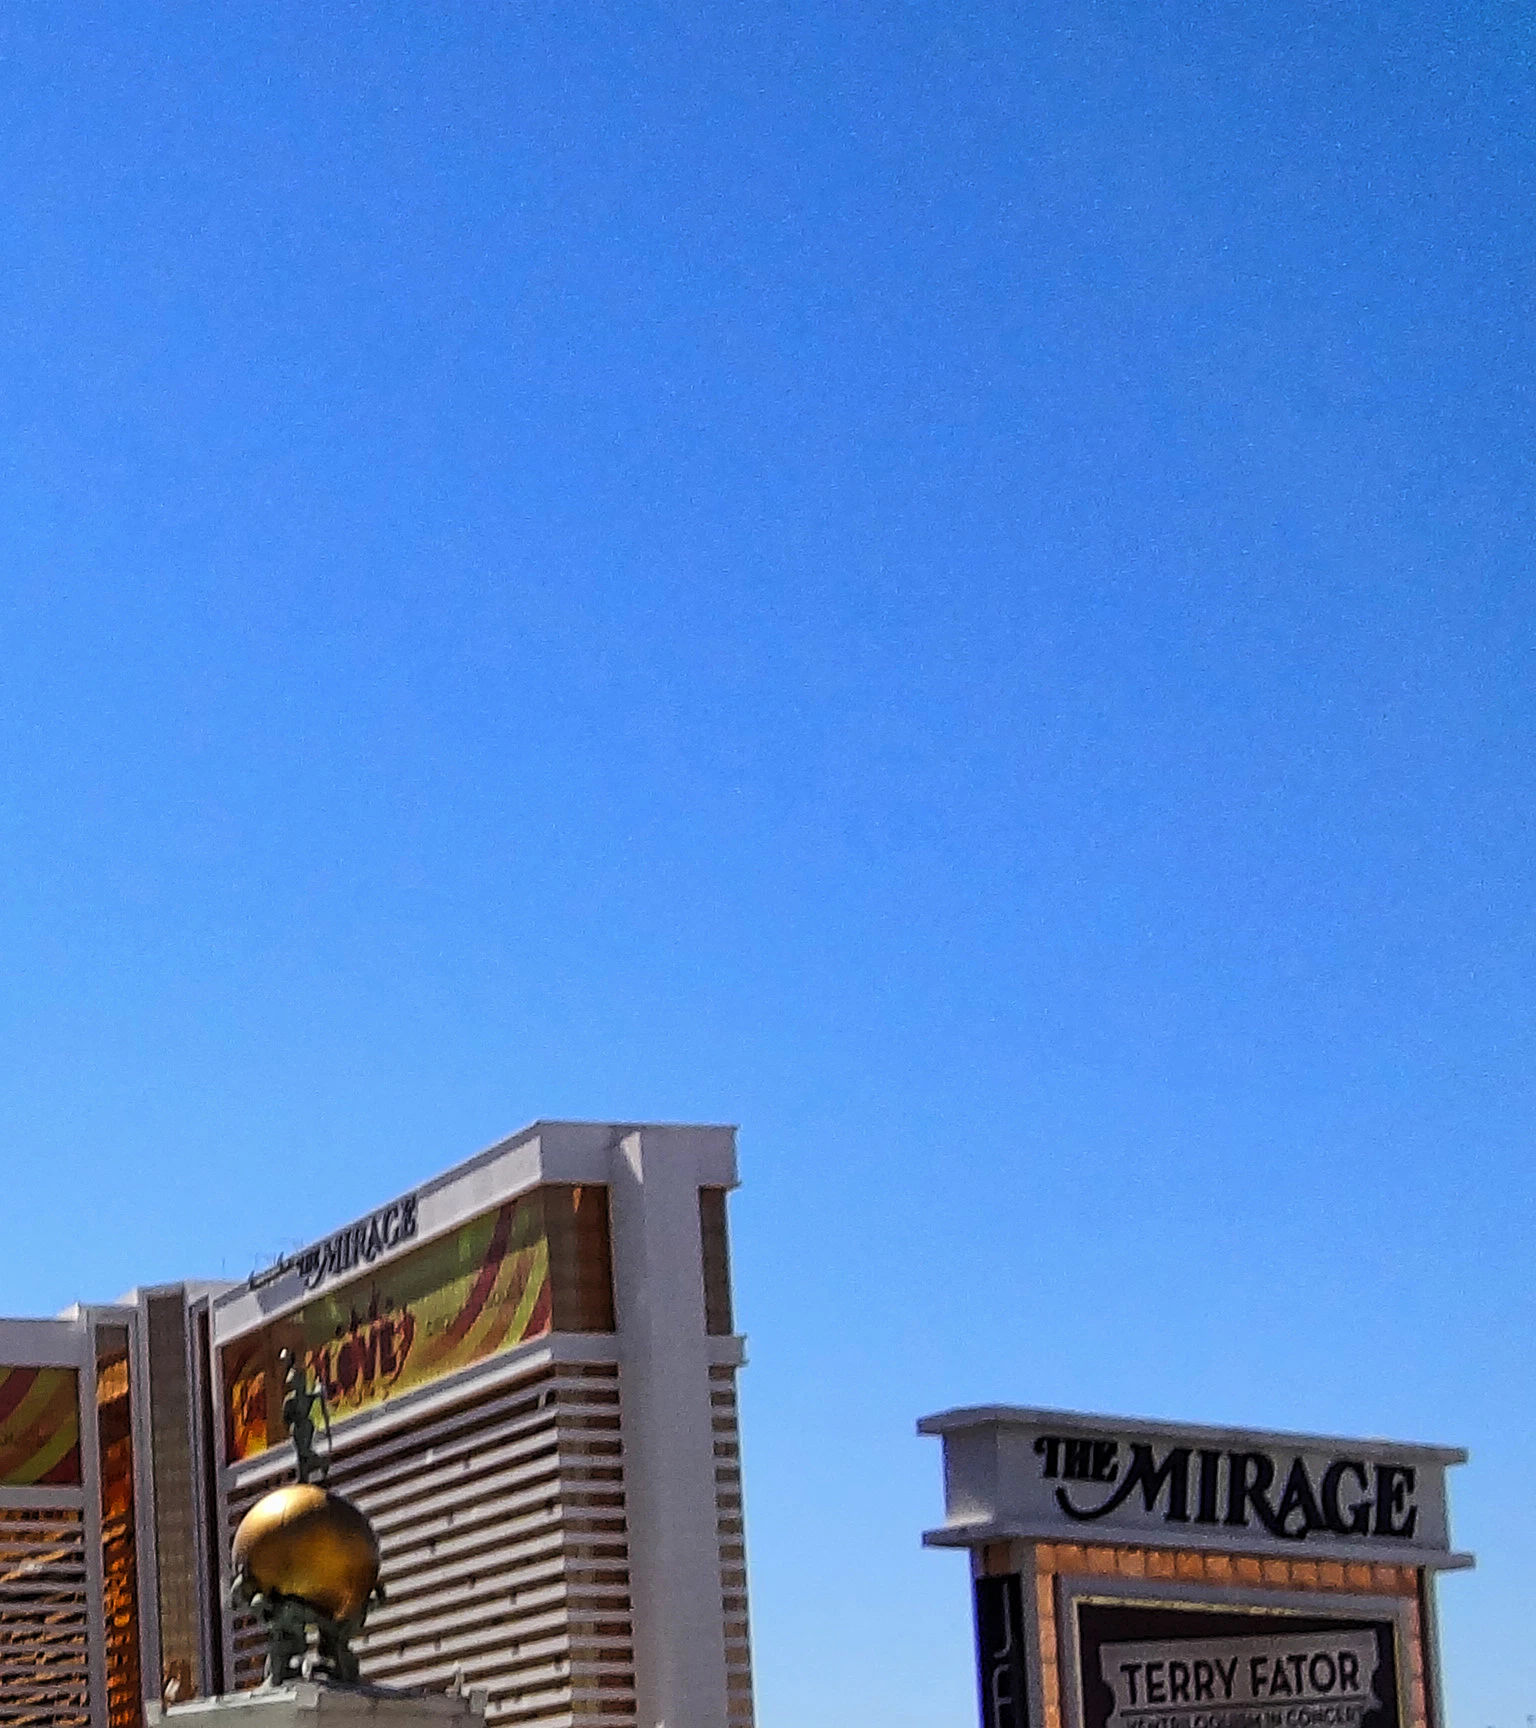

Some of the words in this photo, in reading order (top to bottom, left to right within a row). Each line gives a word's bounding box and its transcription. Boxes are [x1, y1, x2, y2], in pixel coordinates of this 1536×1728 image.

[305, 1194, 417, 1288] MIRAGE
[1034, 1436, 1119, 1482] THE
[1054, 1443, 1419, 1539] MIRAGE
[1120, 1655, 1238, 1704] TERRY
[1248, 1651, 1360, 1698] FATOR
